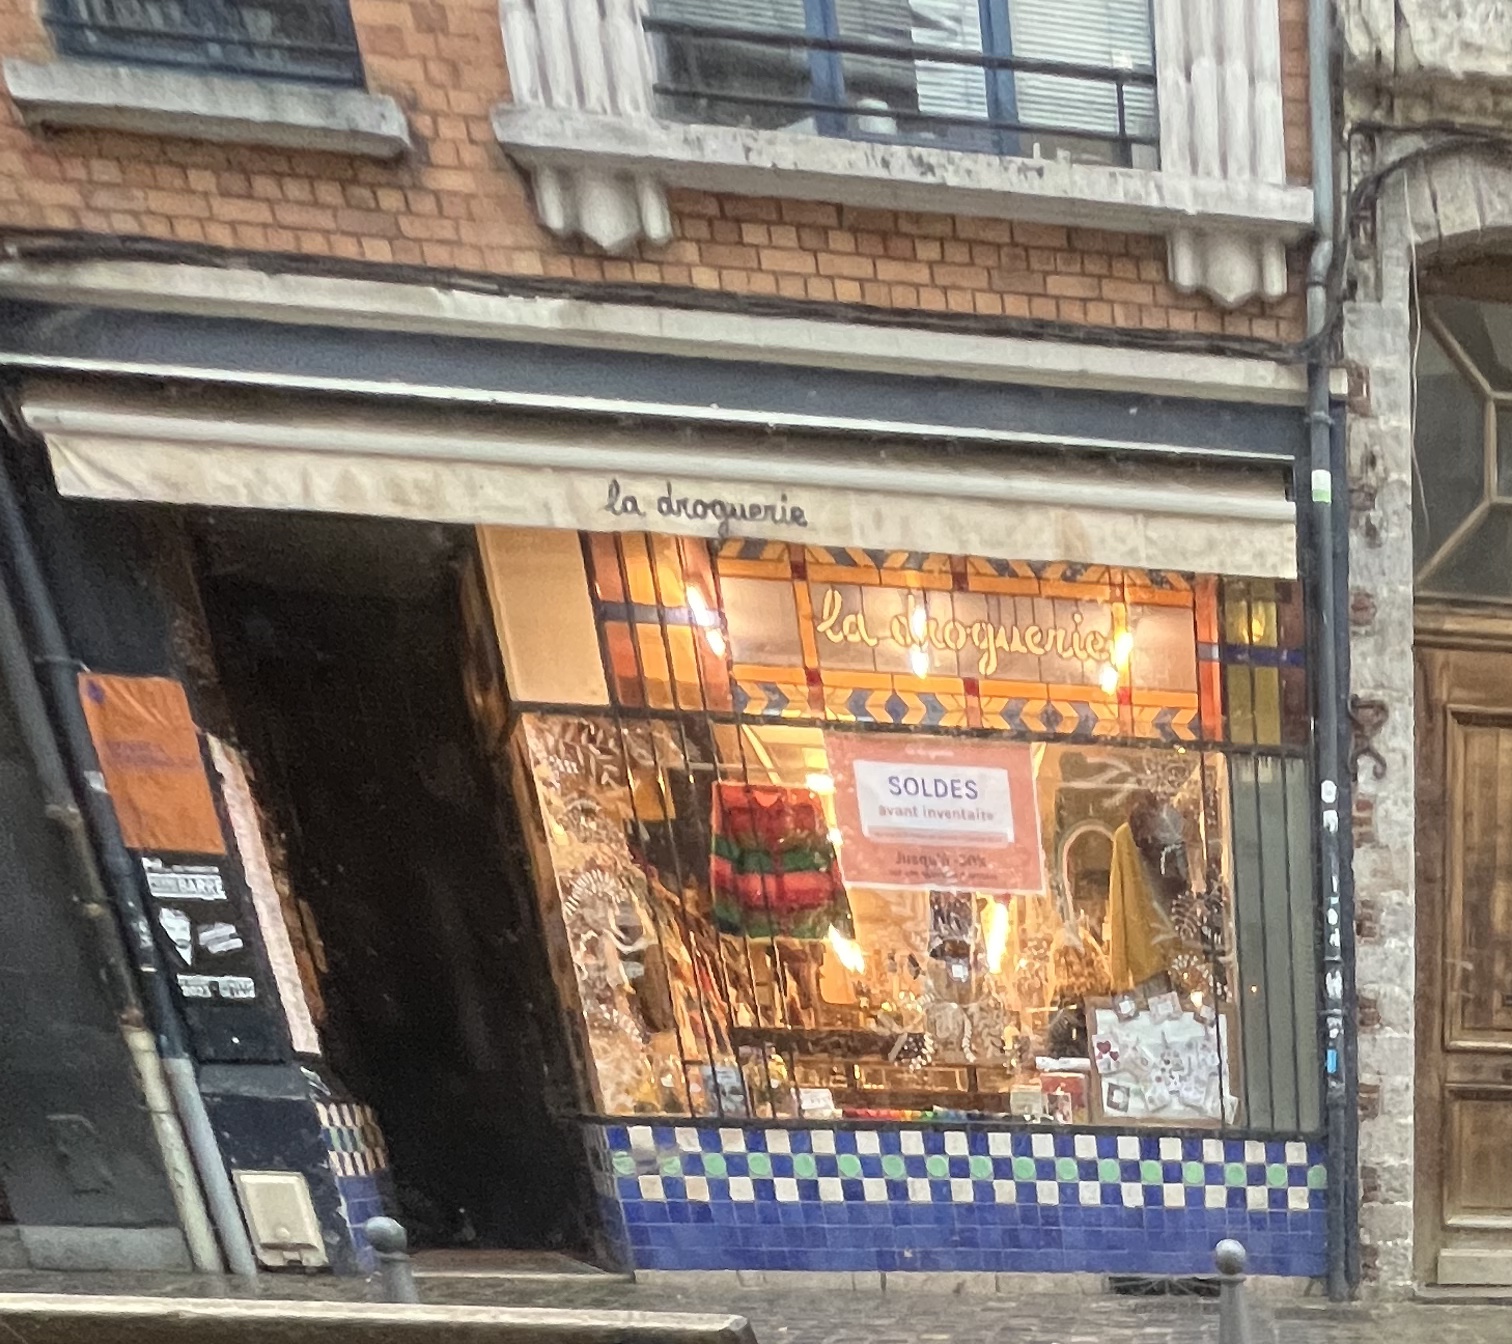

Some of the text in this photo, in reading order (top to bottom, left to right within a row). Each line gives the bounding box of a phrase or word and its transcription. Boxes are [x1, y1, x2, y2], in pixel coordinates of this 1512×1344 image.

[605, 478, 808, 539] la droguerie
[817, 588, 1114, 676] la droguerie
[888, 775, 979, 800] SOLDES
[878, 804, 918, 819] avant
